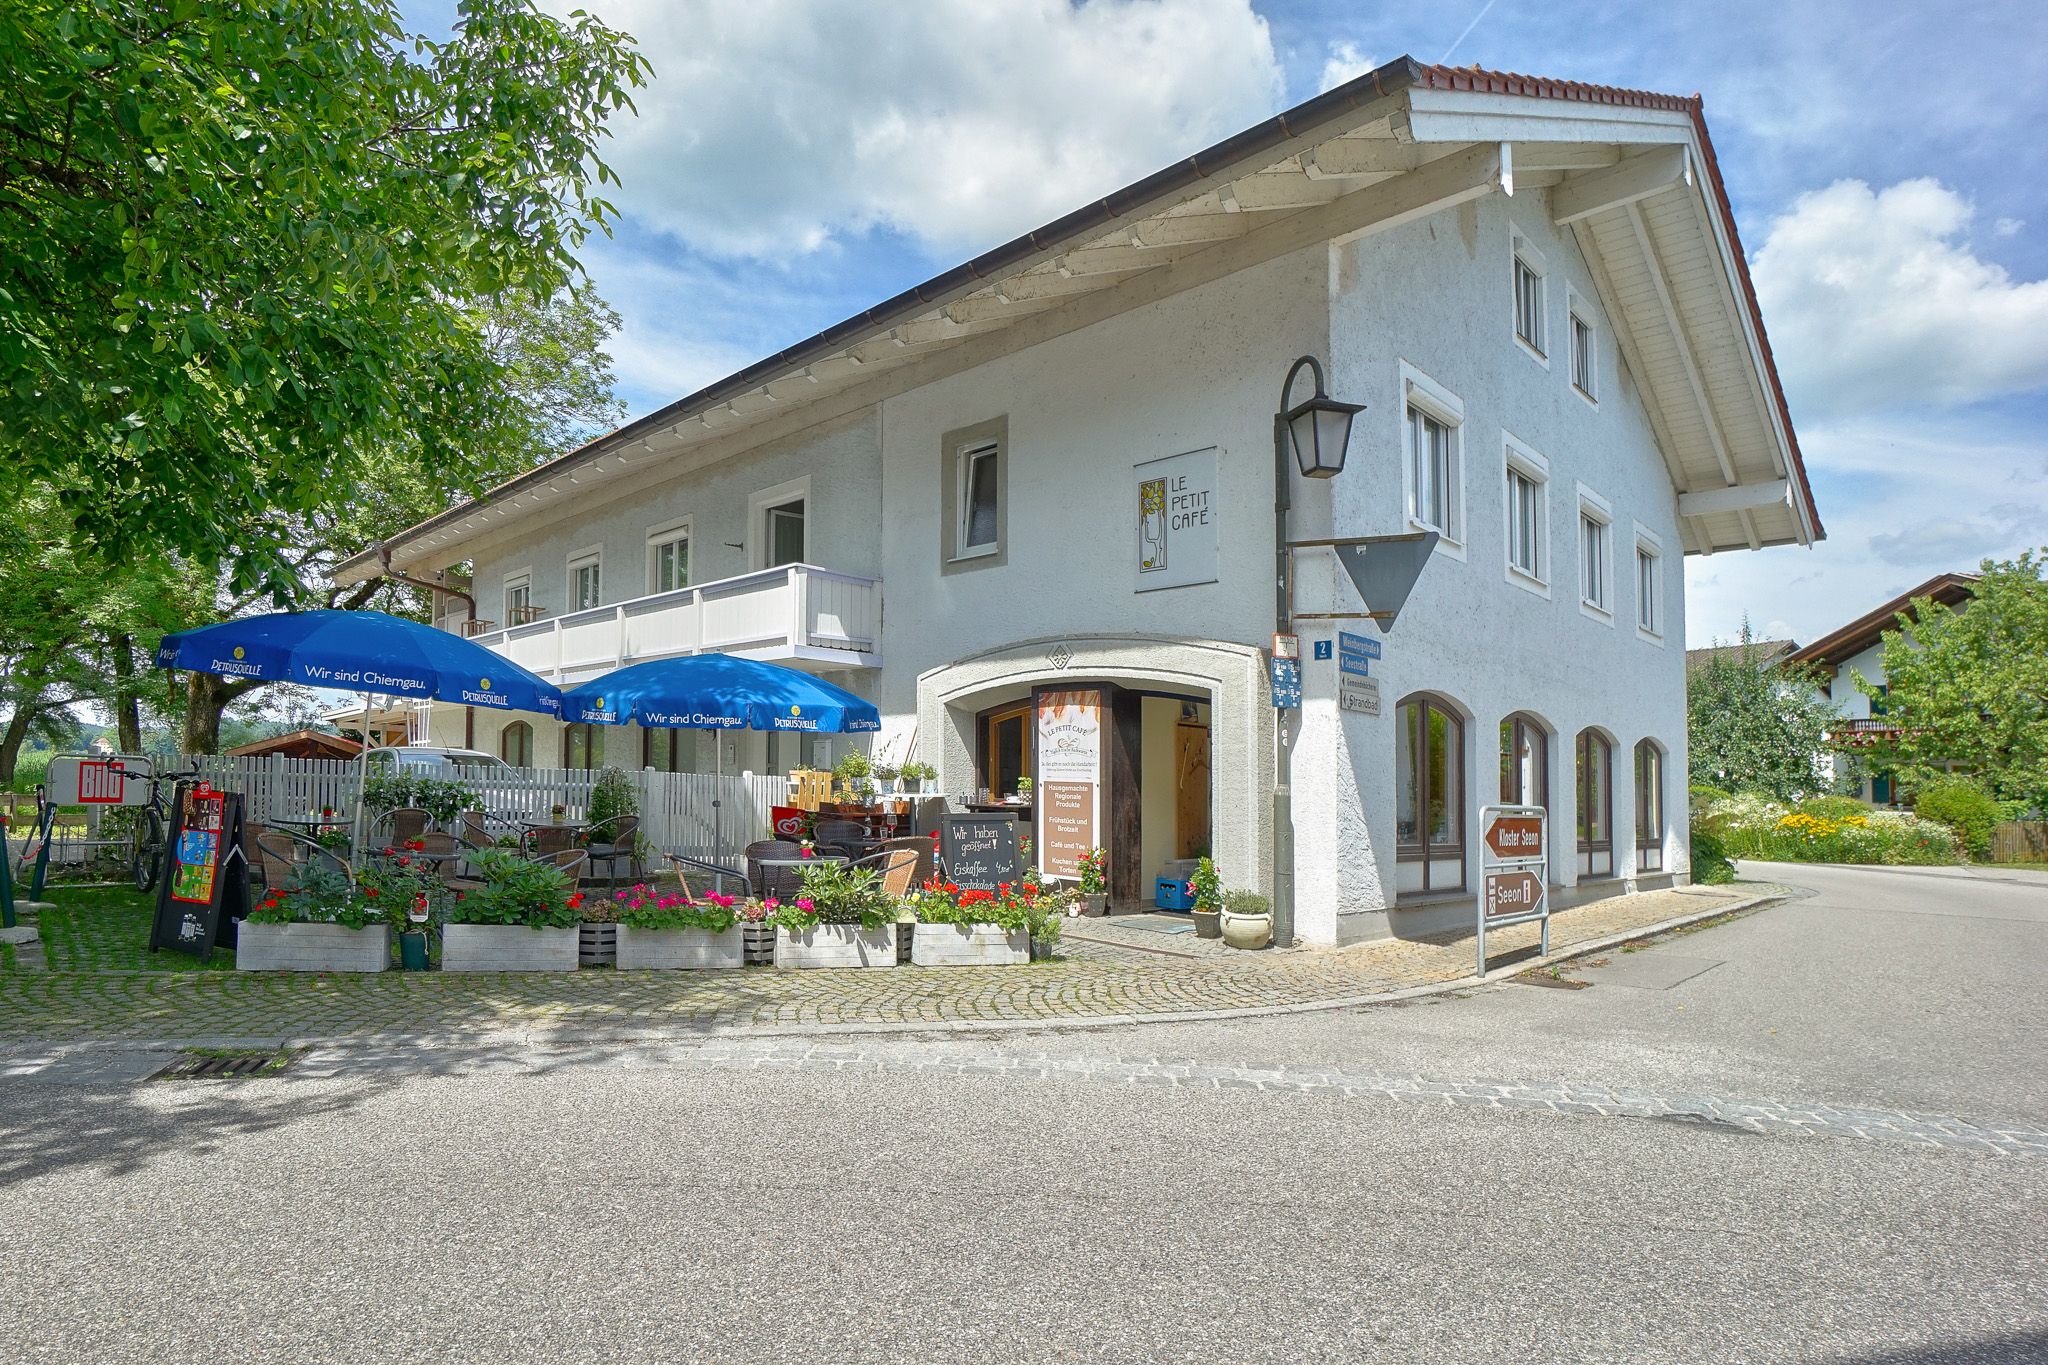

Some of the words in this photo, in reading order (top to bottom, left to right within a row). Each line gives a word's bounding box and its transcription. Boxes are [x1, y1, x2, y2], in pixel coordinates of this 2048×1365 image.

[1171, 476, 1187, 492] LE
[1171, 490, 1210, 511] PETIT
[1171, 506, 1209, 531] CAFÉ
[1320, 642, 1326, 654] 2
[1343, 635, 1377, 655] Weinbergstraße
[211, 659, 262, 676] PETRUSQUELLE
[1345, 656, 1367, 672] Seestraße
[304, 664, 332, 679] Wir
[334, 669, 360, 682] sind
[363, 671, 427, 690] Chiemgau.
[462, 690, 509, 706] PETRUSQUELLE
[1349, 694, 1378, 711] Strandbad
[645, 712, 668, 724] Wir
[669, 713, 690, 724] sind
[692, 713, 742, 727] Chiemgau.
[774, 717, 818, 730] PETRUSQUELLE
[1047, 728, 1056, 737] LE
[1055, 724, 1072, 733] PETIT
[1072, 725, 1089, 737] CAFÉ
[1048, 784, 1089, 793] Hausgemachte
[1054, 792, 1082, 801] Regionale
[1055, 800, 1081, 808] Produkte
[1048, 816, 1076, 825] Frühstück
[953, 826, 968, 840] Wir
[974, 825, 999, 839] haben
[1057, 825, 1079, 833] Brotzeit
[1050, 840, 1063, 848] Café
[1499, 828, 1520, 847] Kloster
[1521, 828, 1539, 846] Seeon
[1051, 856, 1072, 865] Kuchen
[954, 860, 988, 877] Eiskaffee
[1059, 865, 1077, 874] Torten
[1497, 886, 1522, 904] Seeon
